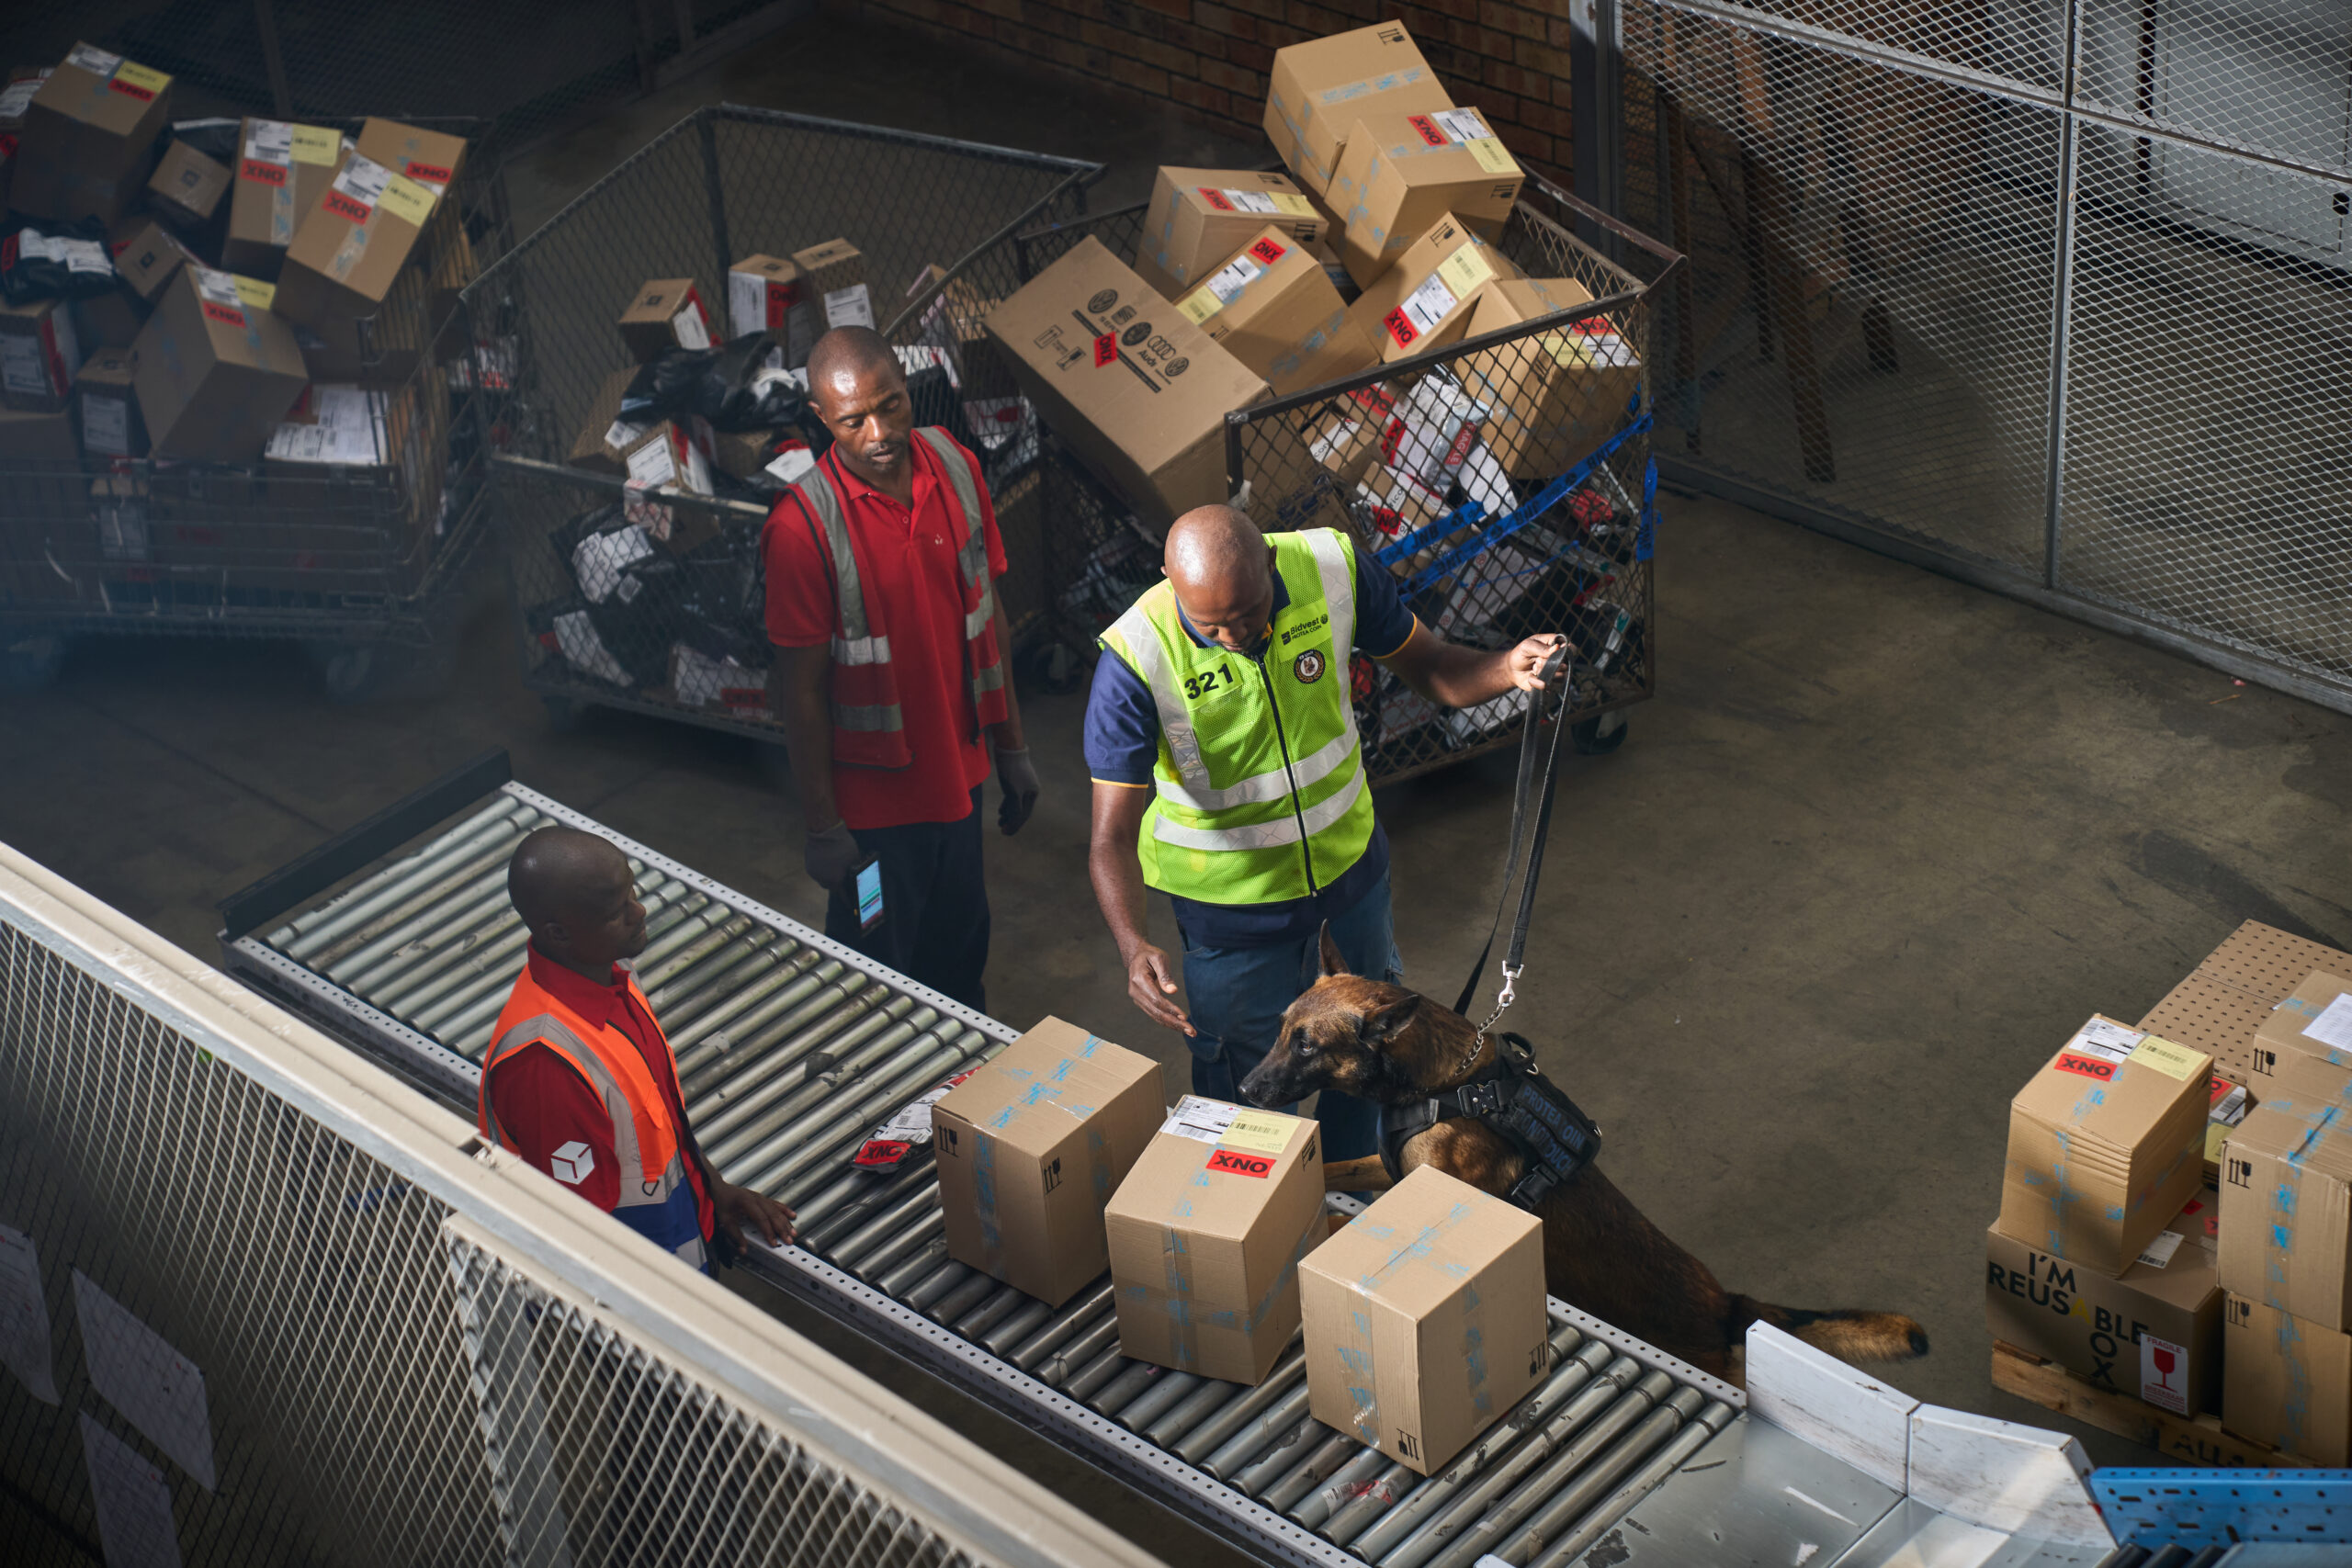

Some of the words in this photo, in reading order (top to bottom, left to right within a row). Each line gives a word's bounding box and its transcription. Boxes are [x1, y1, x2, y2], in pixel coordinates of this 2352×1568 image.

[1137, 349, 1159, 367] Audi
[1411, 525, 1440, 549] JNB
[1290, 617, 1320, 635] Bidvest
[1184, 662, 1234, 700] 321
[1522, 1084, 1563, 1131] PROTEA
[1560, 1121, 1588, 1152] OIN
[1987, 1261, 2149, 1346] REUSABLE
[2146, 1337, 2182, 1354] FRAGILE
